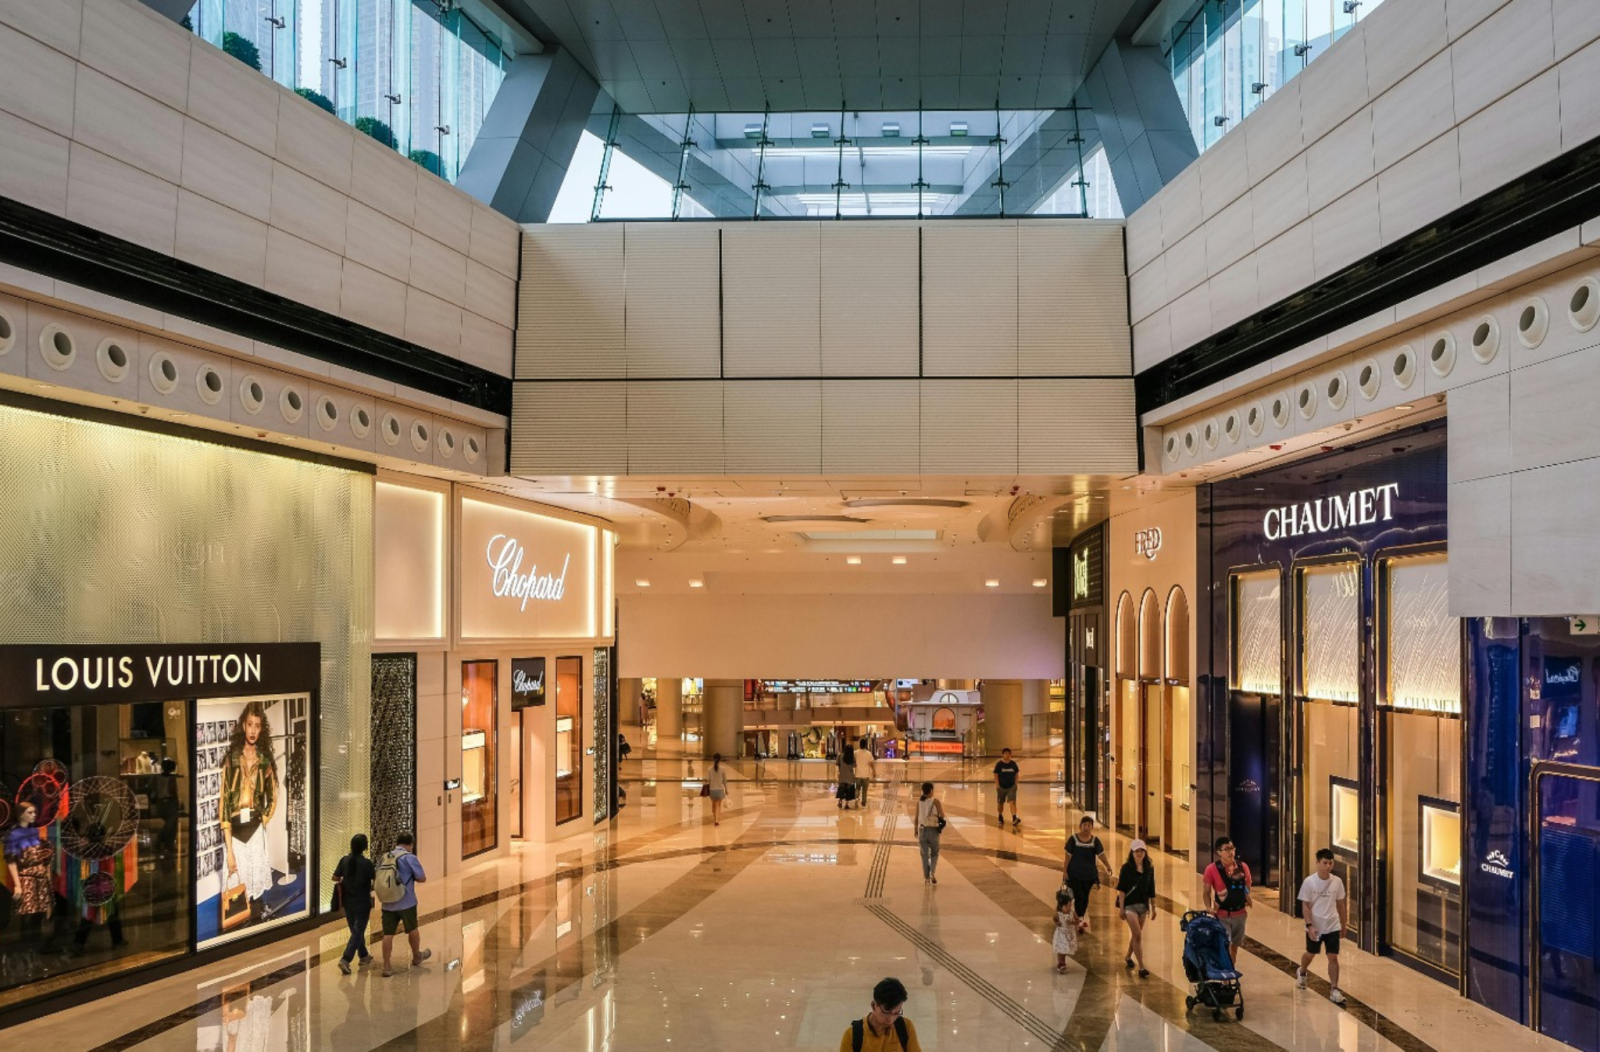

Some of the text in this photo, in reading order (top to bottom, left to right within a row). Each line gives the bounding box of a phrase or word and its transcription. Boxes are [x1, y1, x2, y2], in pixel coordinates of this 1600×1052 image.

[1263, 482, 1399, 540] CHAUMET
[1135, 527, 1161, 560] FRED
[486, 533, 570, 612] Chopard
[36, 653, 261, 691] LOUIS VUITTON
[513, 669, 543, 697] Chopard
[1481, 863, 1514, 879] CHAUMET
